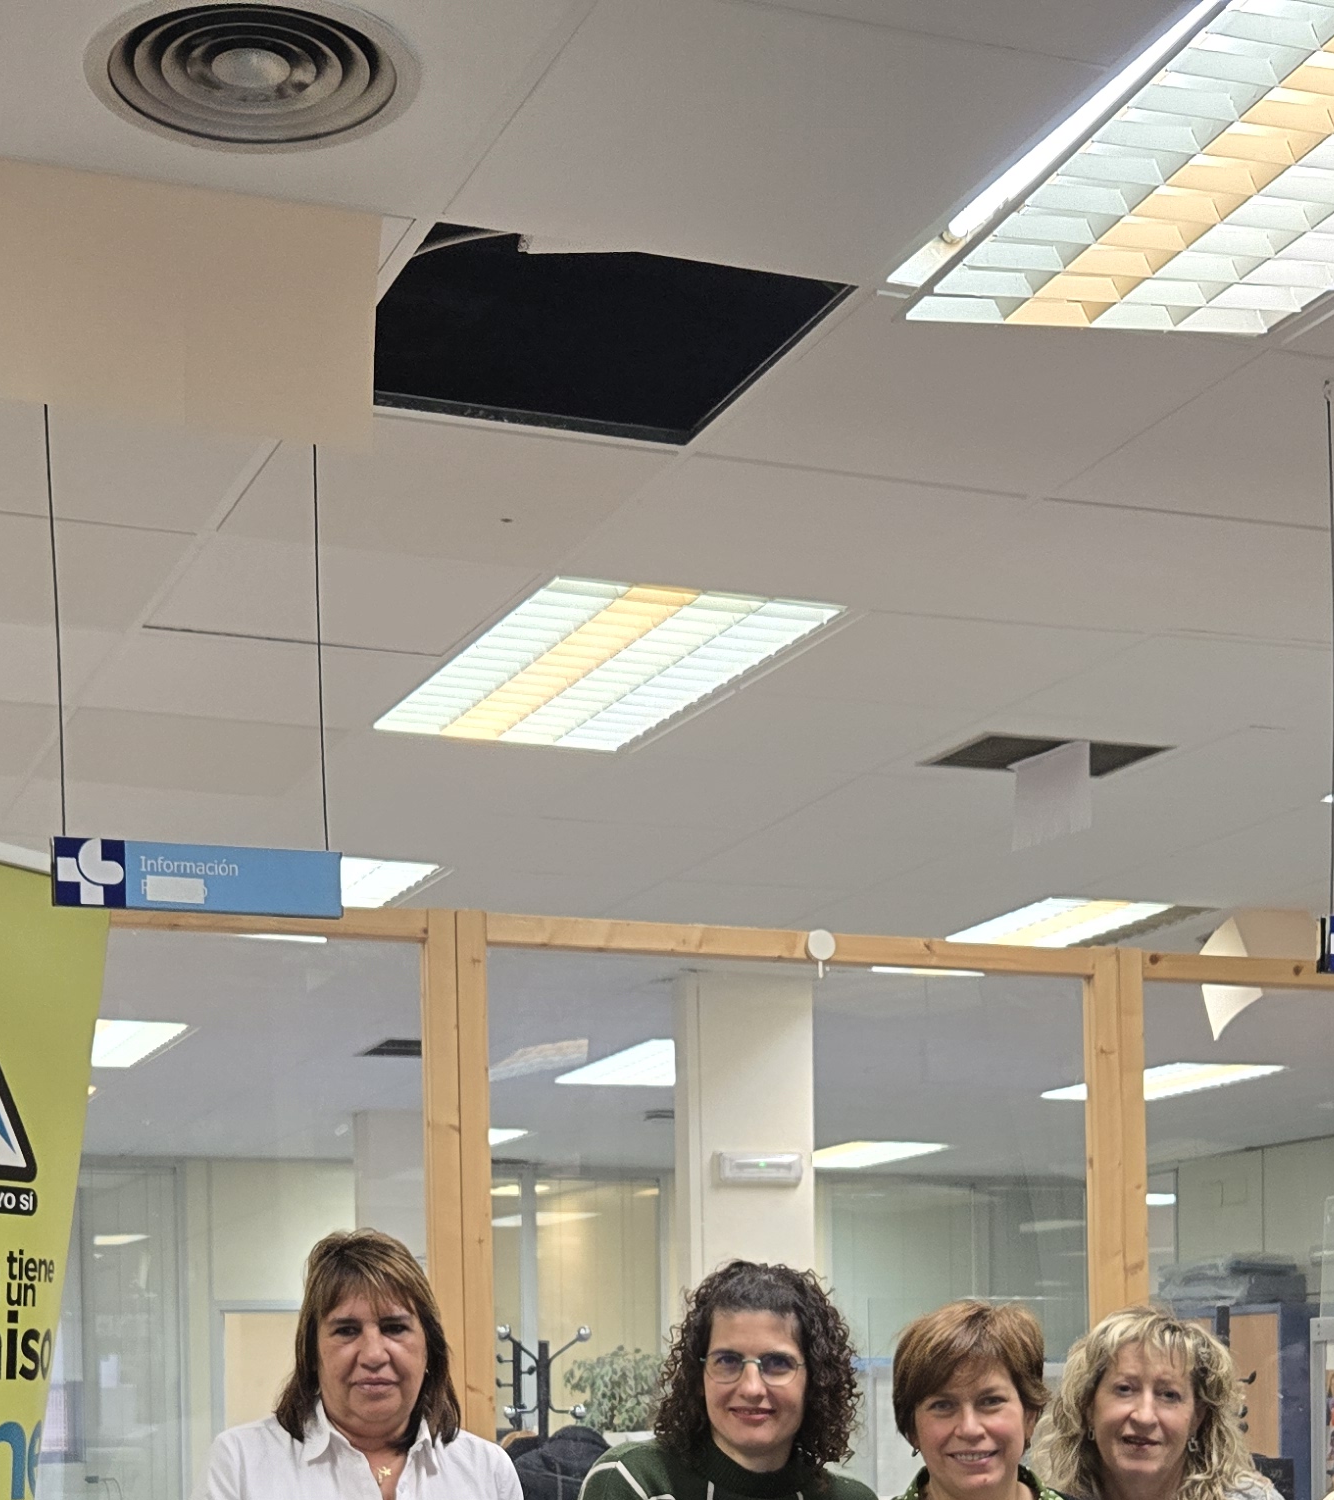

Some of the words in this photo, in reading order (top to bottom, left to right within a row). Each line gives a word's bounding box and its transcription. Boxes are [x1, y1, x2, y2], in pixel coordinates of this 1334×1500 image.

[139, 855, 239, 876] Información
[6, 1248, 55, 1283] tiene
[6, 1281, 36, 1307] un
